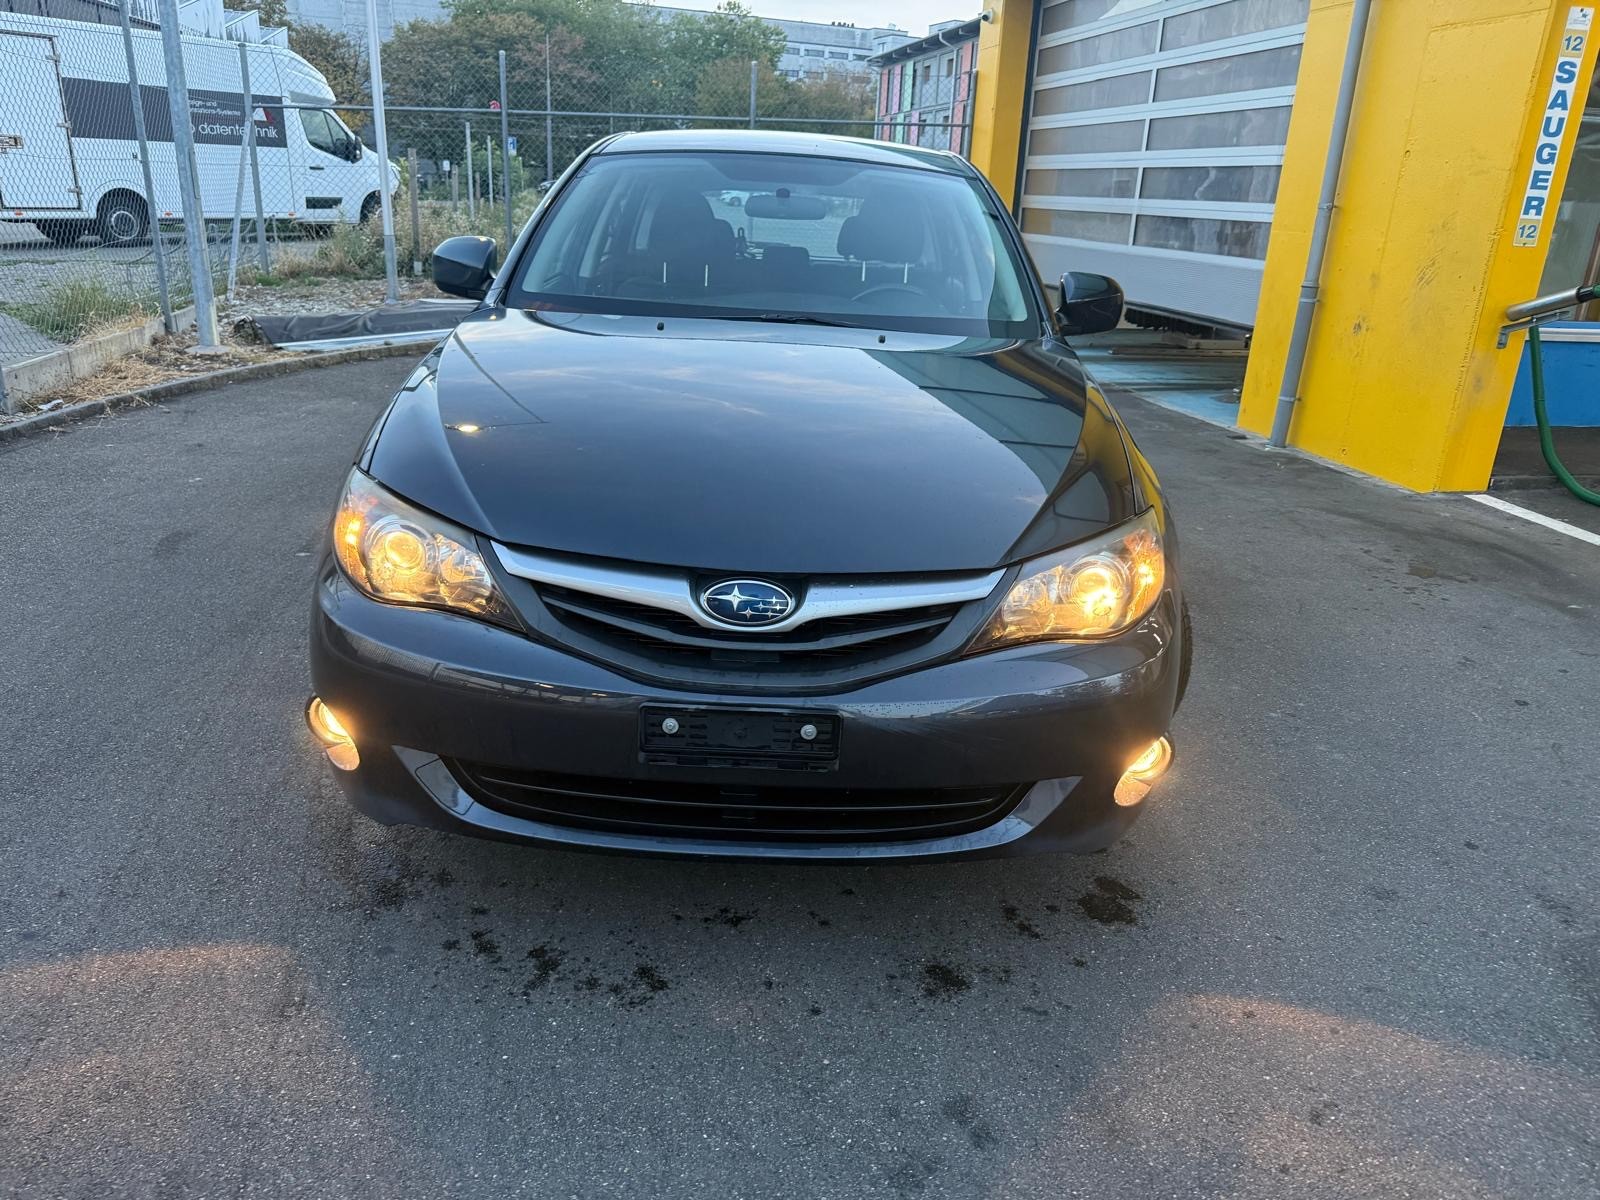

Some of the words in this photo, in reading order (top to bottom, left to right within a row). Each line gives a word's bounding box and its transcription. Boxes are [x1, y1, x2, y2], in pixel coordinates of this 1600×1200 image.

[1564, 35, 1584, 52] 12
[198, 122, 279, 138] datentehnik
[1522, 60, 1578, 217] SAUGER
[1519, 224, 1537, 239] 12
